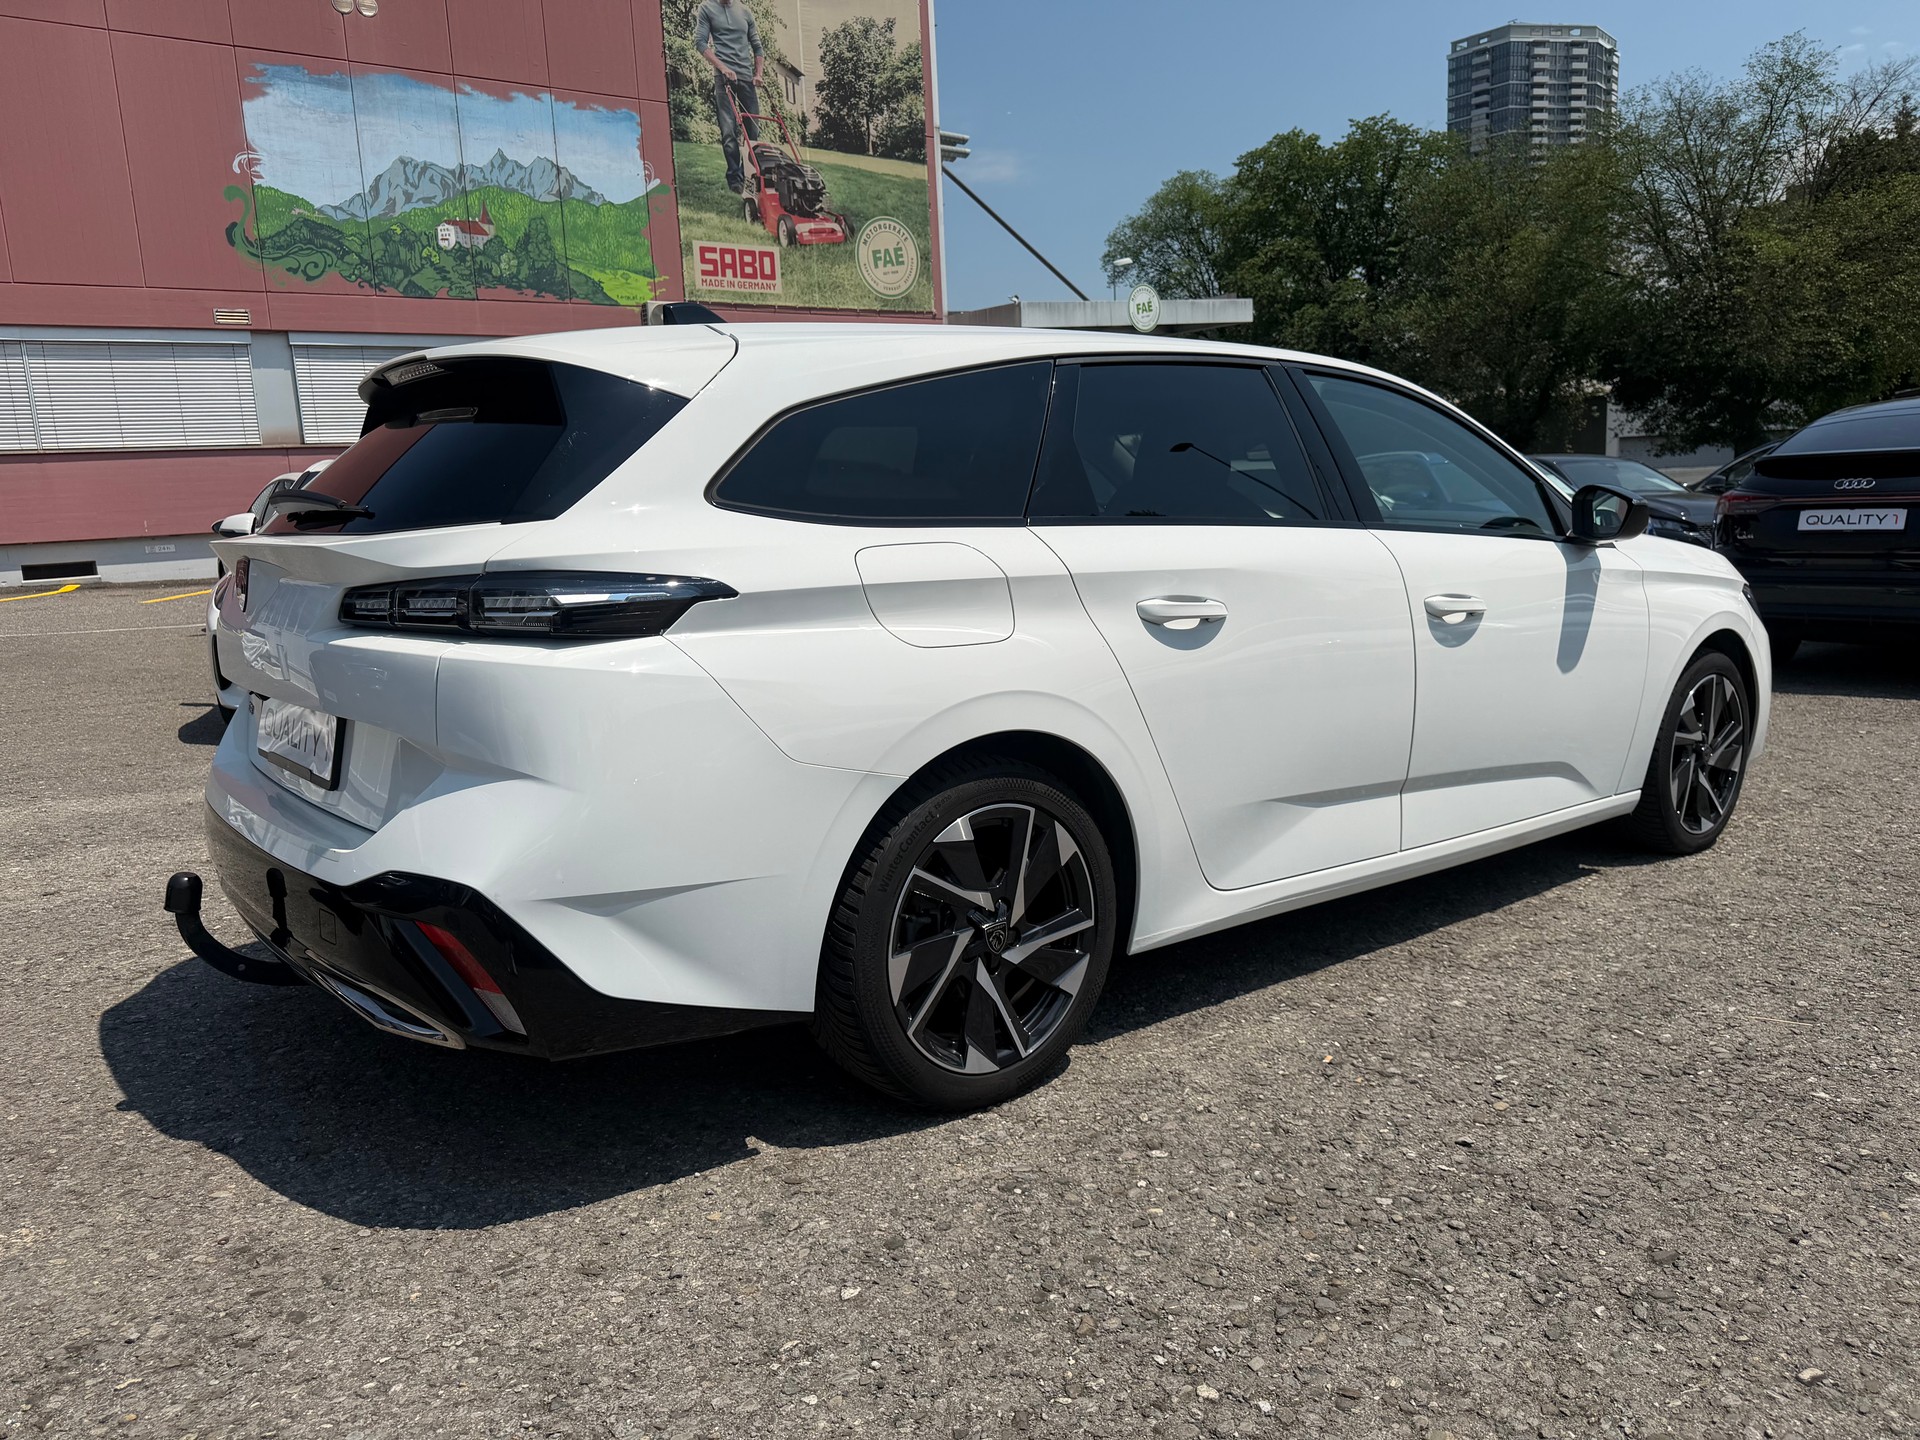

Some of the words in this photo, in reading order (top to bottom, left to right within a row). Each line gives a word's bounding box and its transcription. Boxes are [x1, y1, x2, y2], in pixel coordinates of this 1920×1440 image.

[862, 223, 910, 247] MOTORGERÄTE
[698, 246, 777, 281] SABO
[872, 241, 905, 270] FAÉ
[701, 278, 726, 289] MADE
[727, 280, 736, 289] IN
[737, 281, 777, 291] GERMANY
[1806, 514, 1888, 526] QUALITY
[1892, 514, 1899, 525] 1
[264, 708, 322, 756] QUALITY
[878, 809, 937, 893] WinterContact
